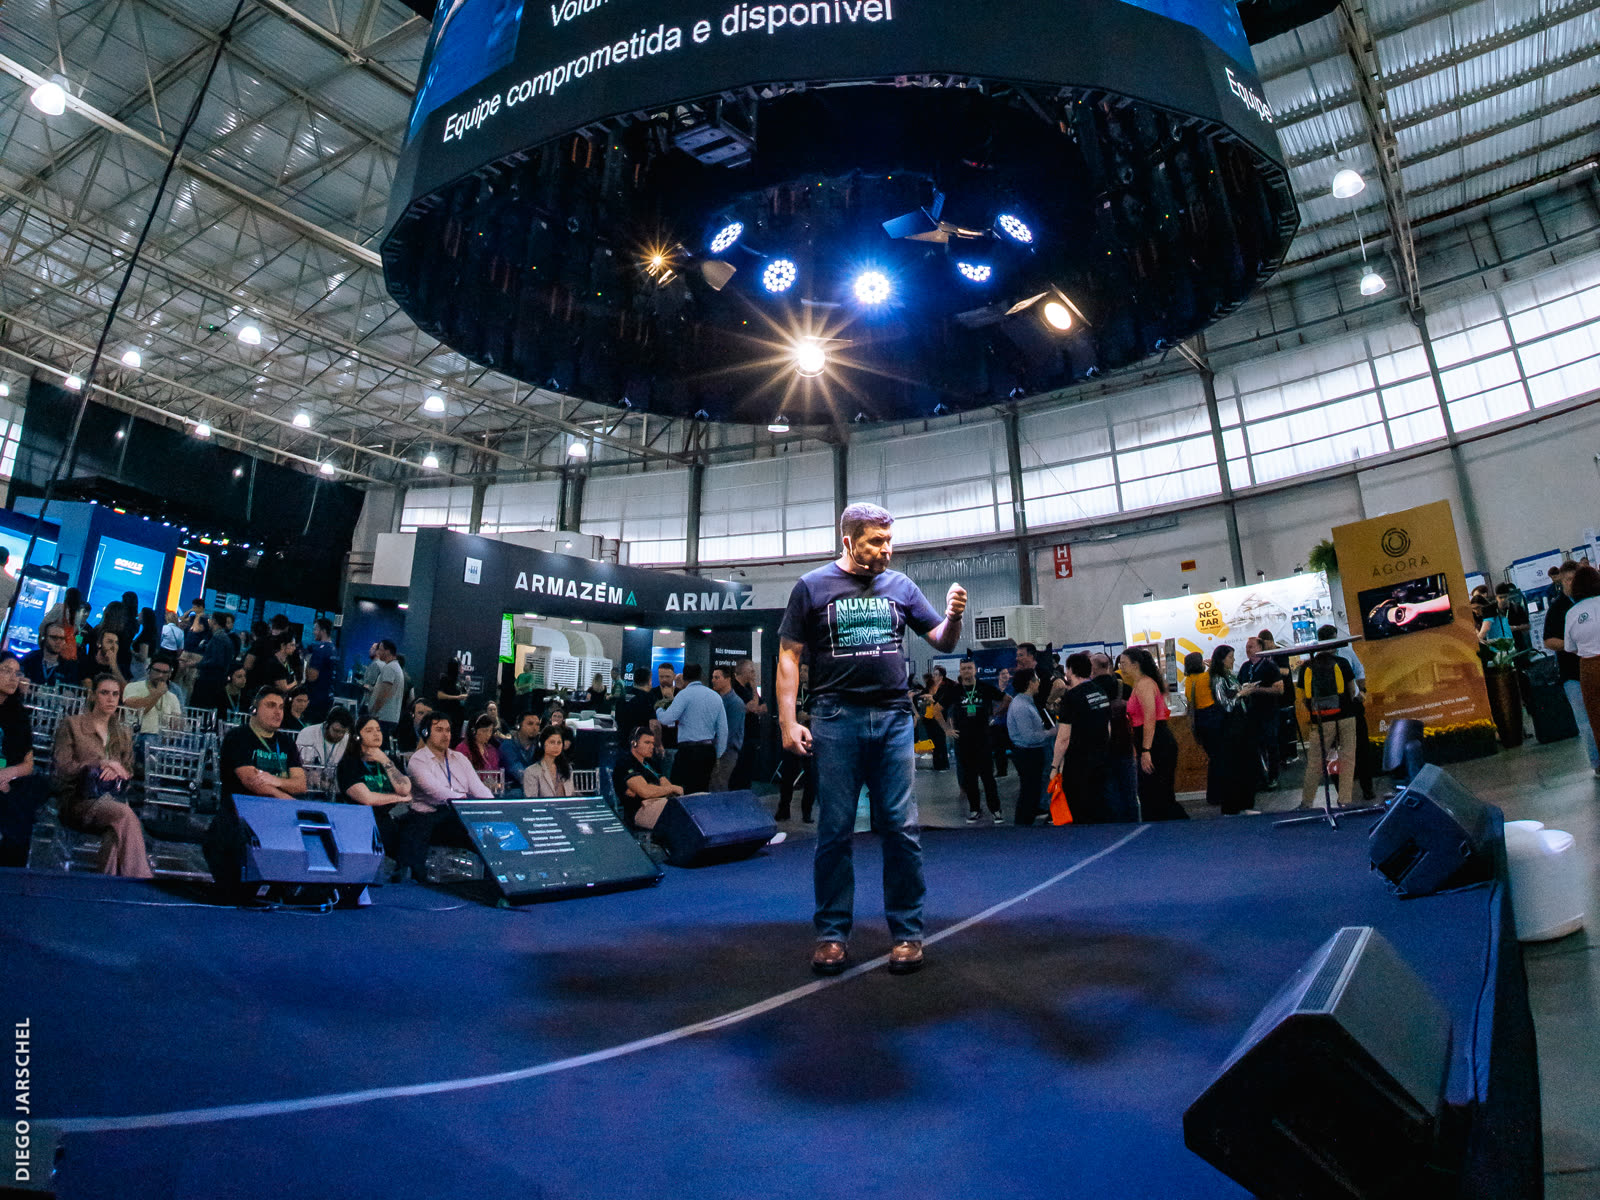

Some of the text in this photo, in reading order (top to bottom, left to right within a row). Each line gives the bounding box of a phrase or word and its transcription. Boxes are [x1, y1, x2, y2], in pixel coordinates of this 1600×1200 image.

[442, 92, 502, 144] Equipe
[505, 22, 683, 109] comprometida
[692, 20, 712, 44] e
[1225, 66, 1274, 124] Equipe
[1057, 545, 1068, 558] H
[514, 571, 624, 606] ARMAZÉM
[835, 597, 890, 612] NUVEM
[1197, 601, 1212, 610] CO
[1199, 609, 1219, 619] NEC
[1199, 617, 1219, 627] TAR
